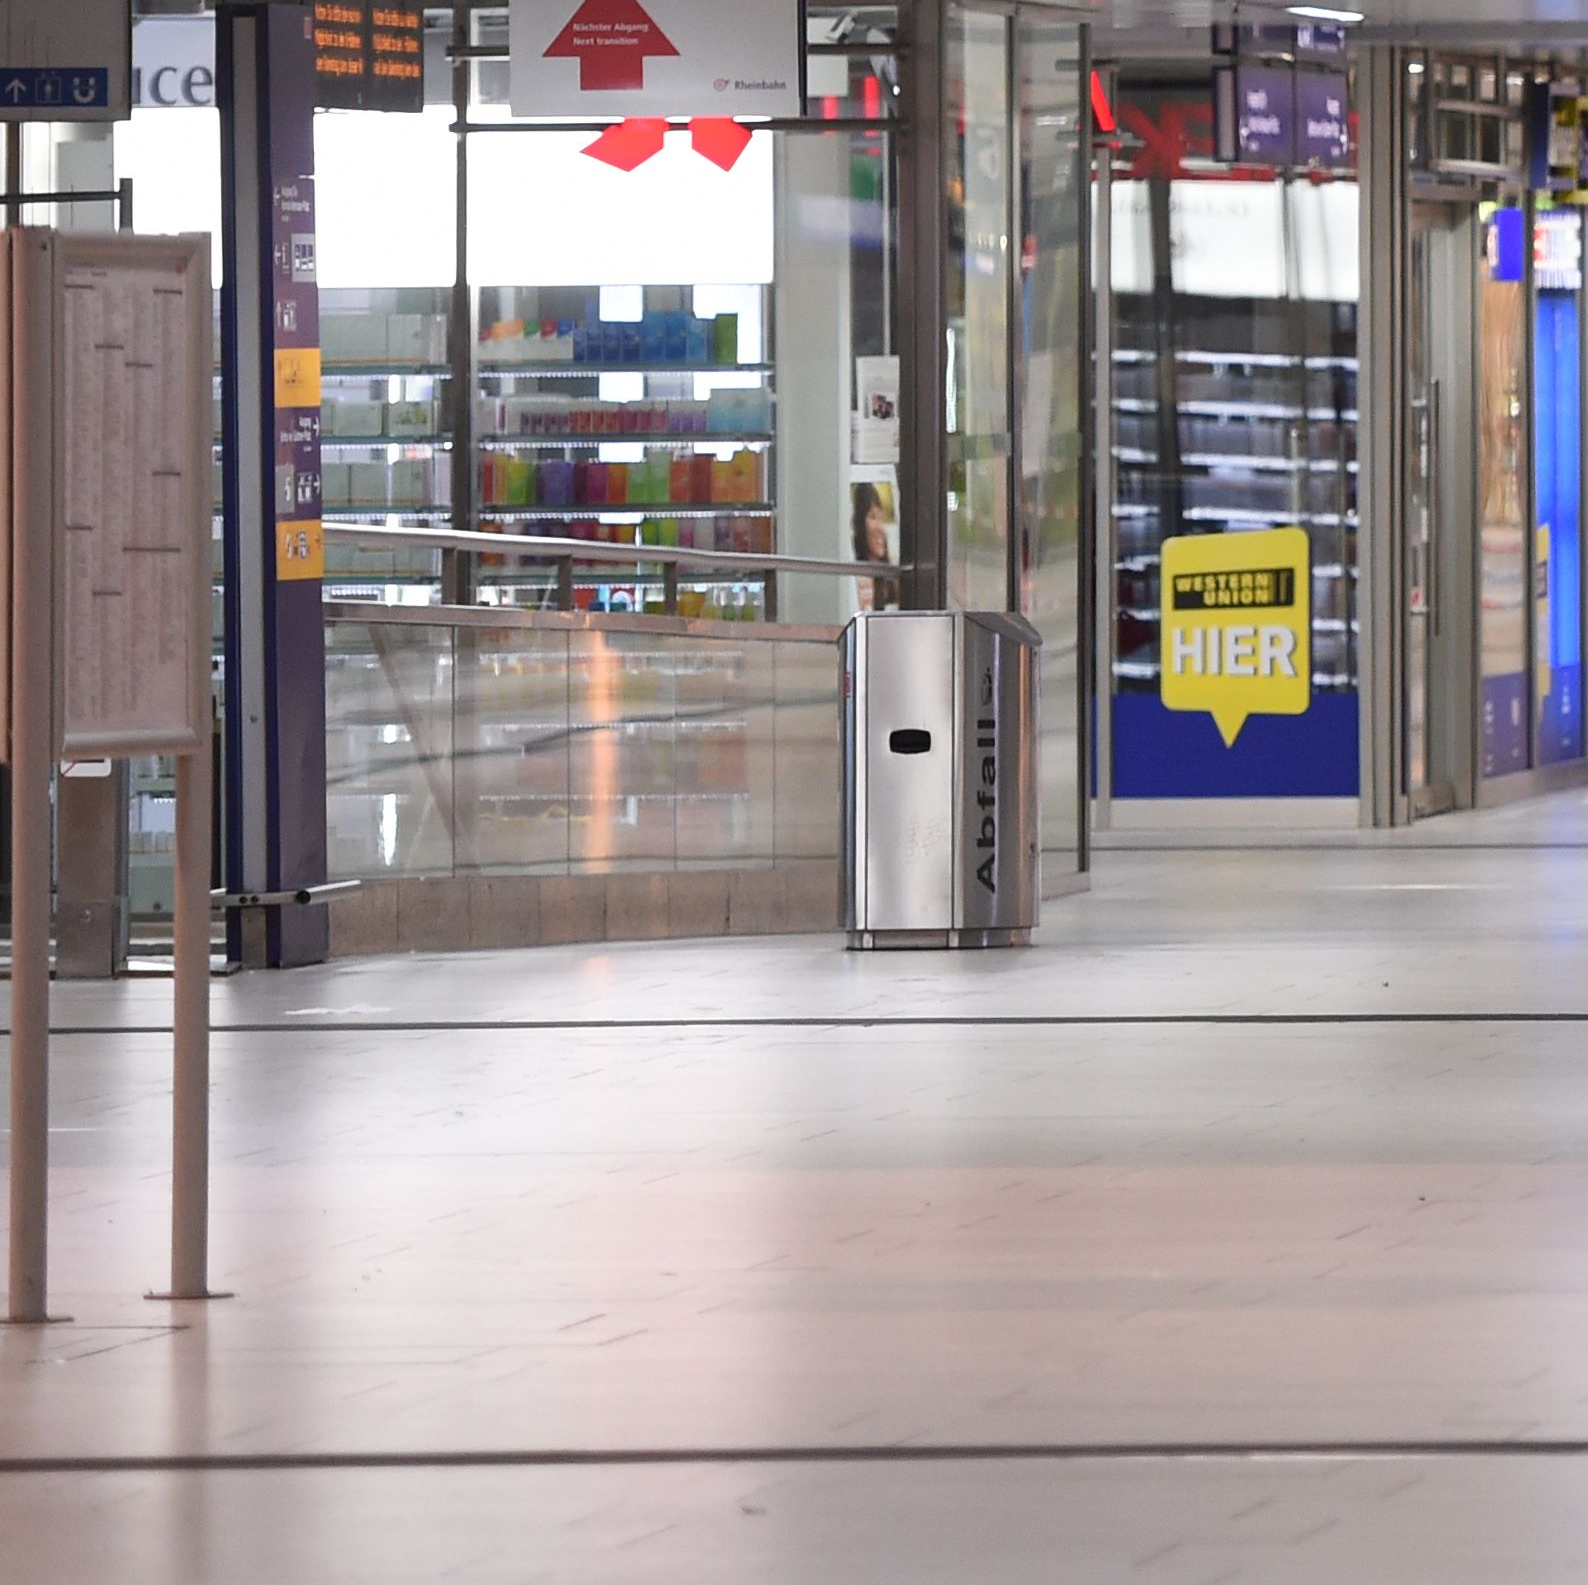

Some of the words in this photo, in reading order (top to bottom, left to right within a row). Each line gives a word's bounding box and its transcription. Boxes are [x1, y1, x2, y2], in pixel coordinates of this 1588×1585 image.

[614, 23, 648, 33] Abgang
[573, 37, 594, 46] Next
[597, 37, 638, 46] transition
[734, 80, 786, 90] Rheinbahn
[1176, 573, 1269, 592] WESTERN
[1204, 588, 1270, 606] UNION
[1173, 625, 1297, 677] HIER
[977, 719, 995, 893] Abfall
